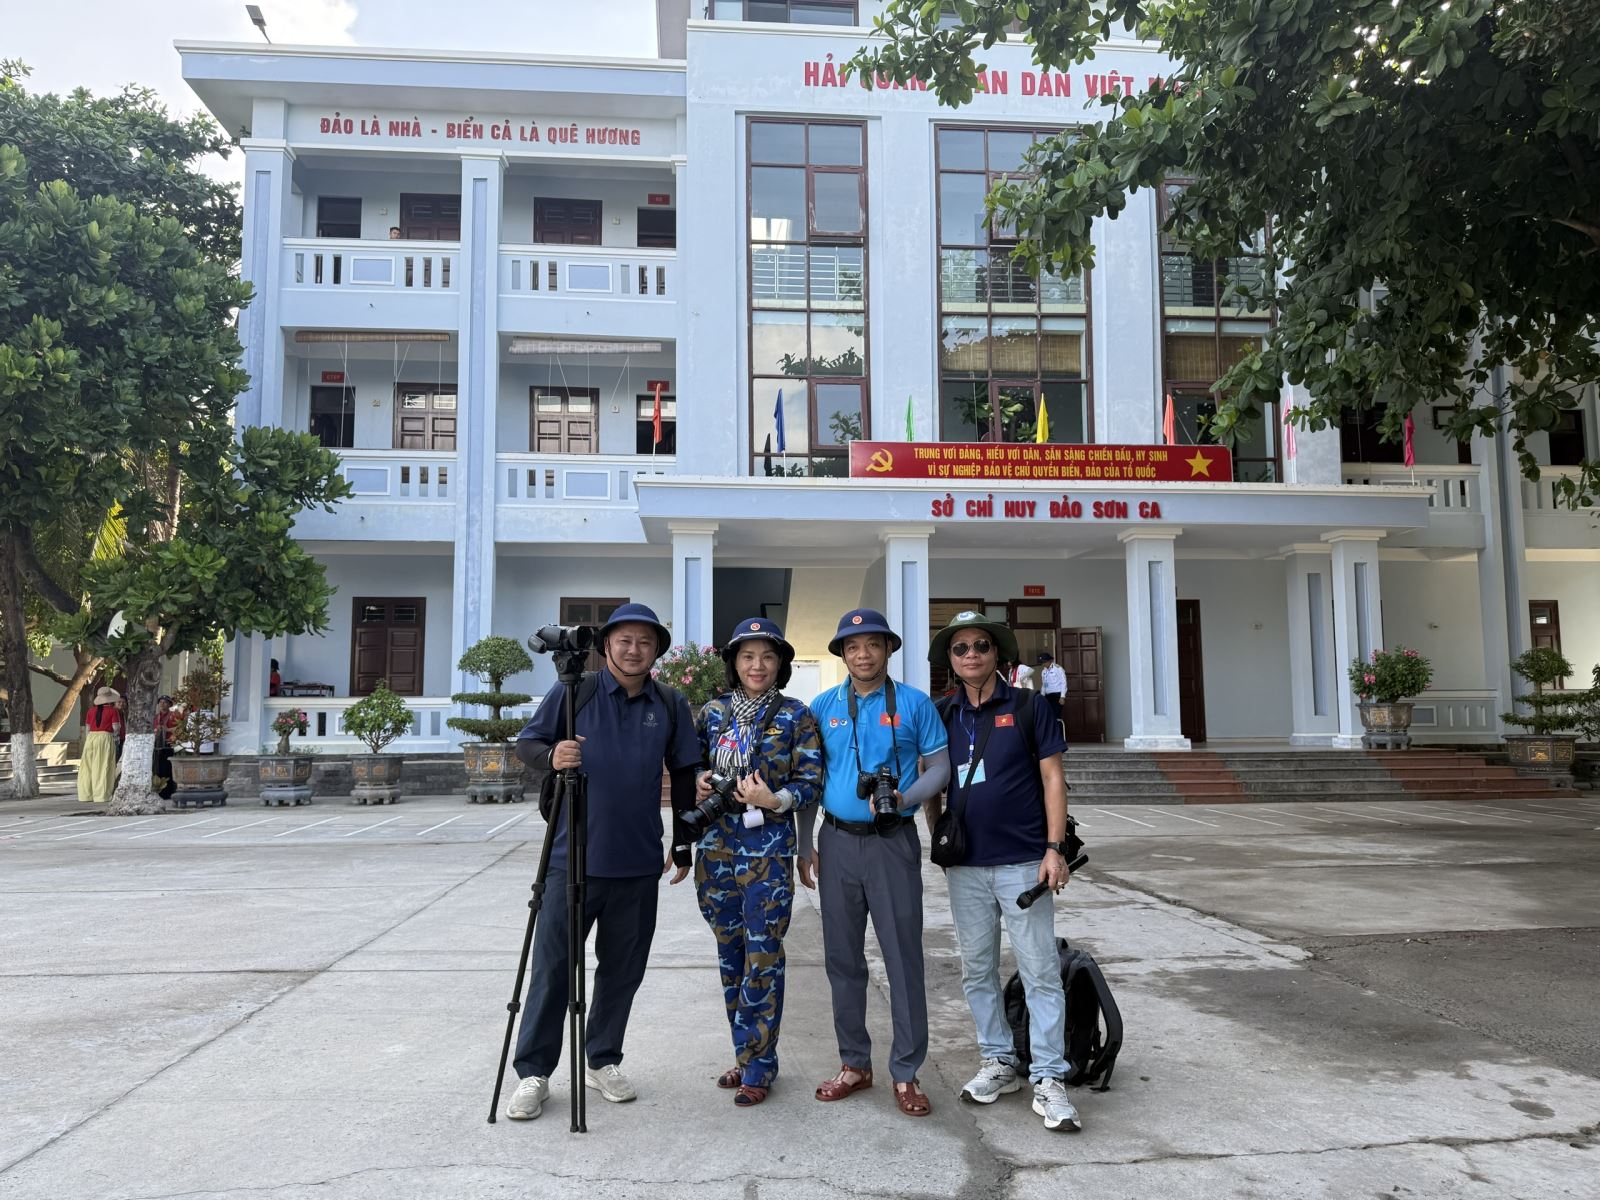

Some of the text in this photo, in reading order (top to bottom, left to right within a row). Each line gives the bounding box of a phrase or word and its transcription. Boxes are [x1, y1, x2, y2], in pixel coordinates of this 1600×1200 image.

[320, 111, 353, 135] ĐẢO
[360, 114, 381, 136] LÀ
[388, 115, 422, 137] NHÀ
[446, 116, 483, 139] BIỂN
[490, 119, 512, 141] CẢ
[519, 120, 540, 142] LÀ
[547, 123, 578, 144] QUÊ
[585, 127, 641, 145] HƯƠNG
[914, 447, 941, 459] TRUNG
[943, 445, 957, 459] VỚI
[986, 445, 1004, 460] HIẾU
[1007, 446, 1020, 460] VỚI
[1023, 447, 1042, 461] DÂN,
[1064, 447, 1086, 461] SÀNG
[1088, 446, 1113, 461] CHIẾN
[1135, 450, 1146, 461] HY
[1149, 450, 1168, 461] SINH
[927, 462, 936, 476] VÌ
[938, 464, 951, 478] SỰ
[952, 462, 981, 478] NGHIỆP
[984, 461, 1001, 476] BẢO
[1002, 462, 1012, 478] VỆ
[1014, 461, 1031, 476] CHỦ
[1085, 461, 1101, 477] ĐẢO
[1104, 462, 1120, 477] CỦA
[1123, 461, 1134, 478] TỔ
[1135, 463, 1156, 478] QUỐC
[931, 493, 1161, 519] SỞ CHỈ HUY ĐẢO SƠN CA
